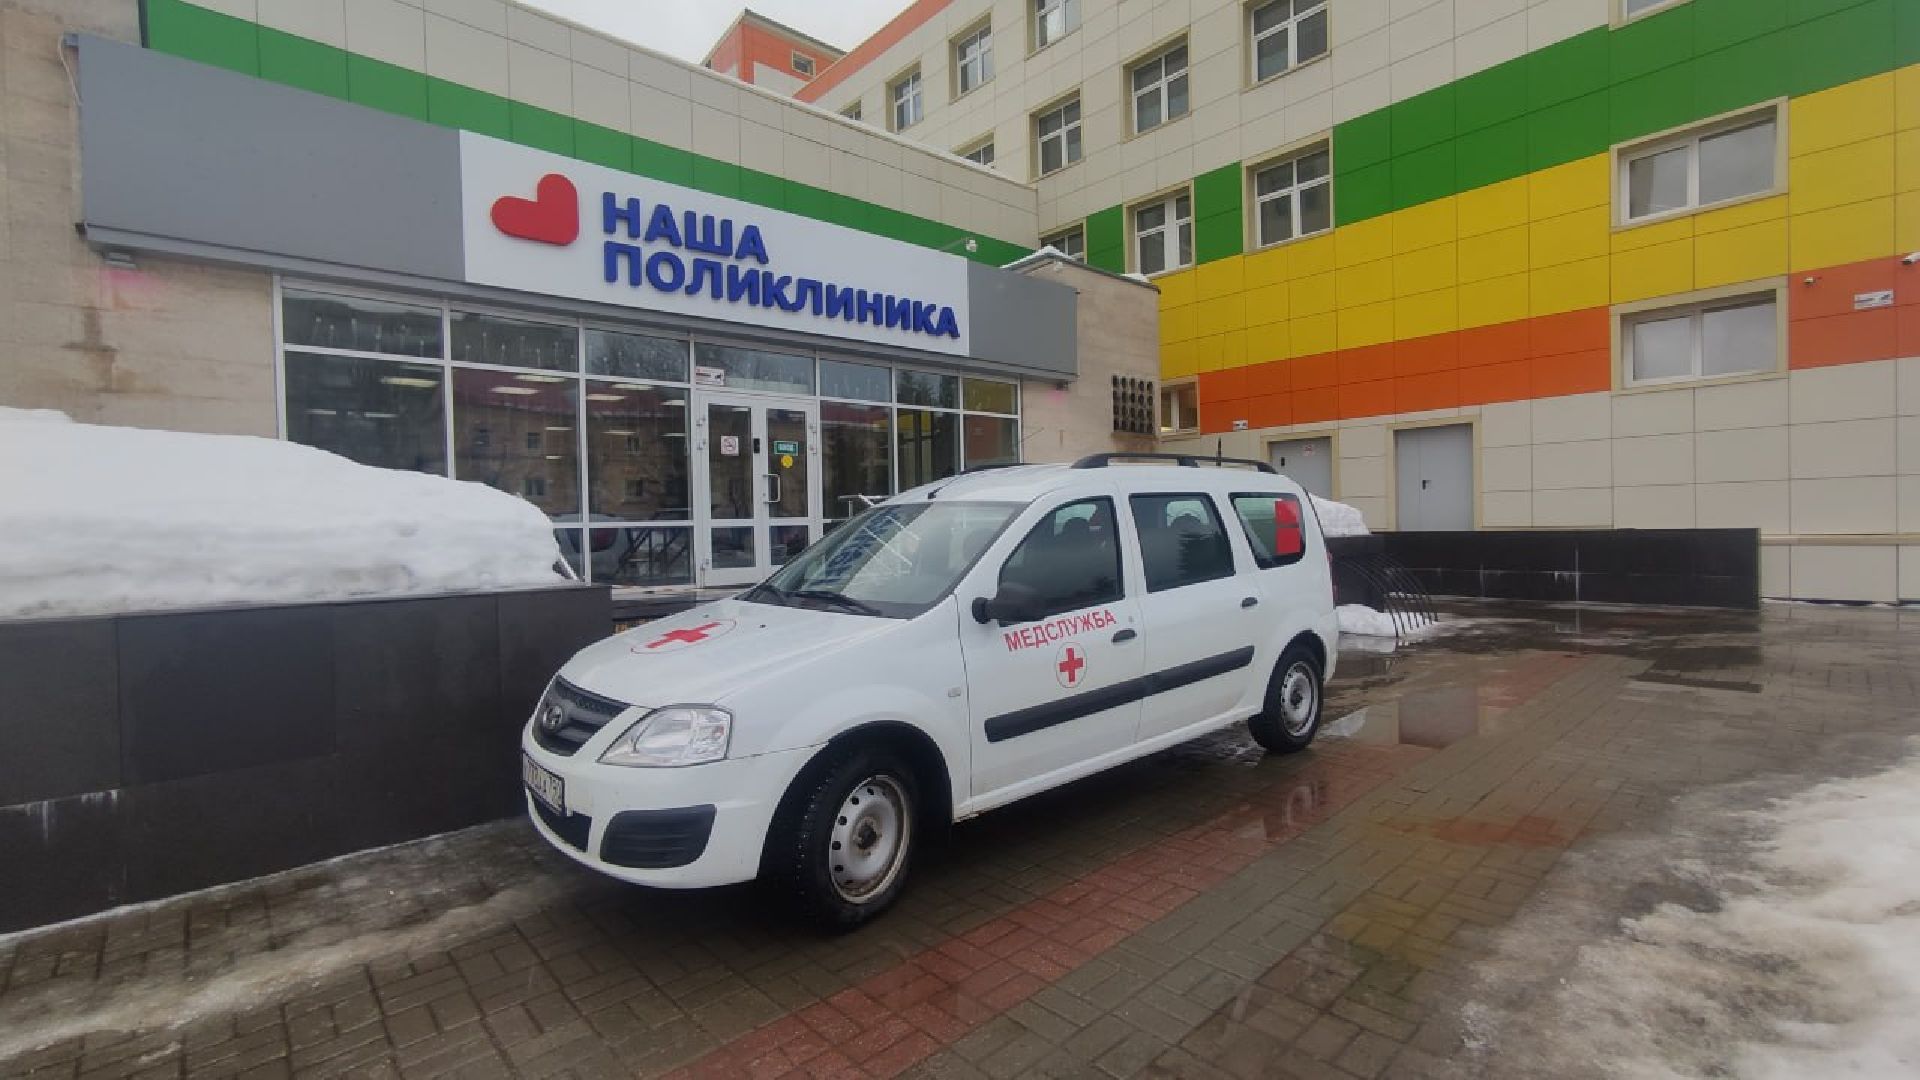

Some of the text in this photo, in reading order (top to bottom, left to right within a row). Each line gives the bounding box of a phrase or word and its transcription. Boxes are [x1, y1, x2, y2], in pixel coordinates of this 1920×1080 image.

[603, 192, 768, 263] НАША
[603, 241, 960, 339] ПОЛИКЛИНИКА
[1004, 609, 1117, 652] МЕДСЛУЖБА
